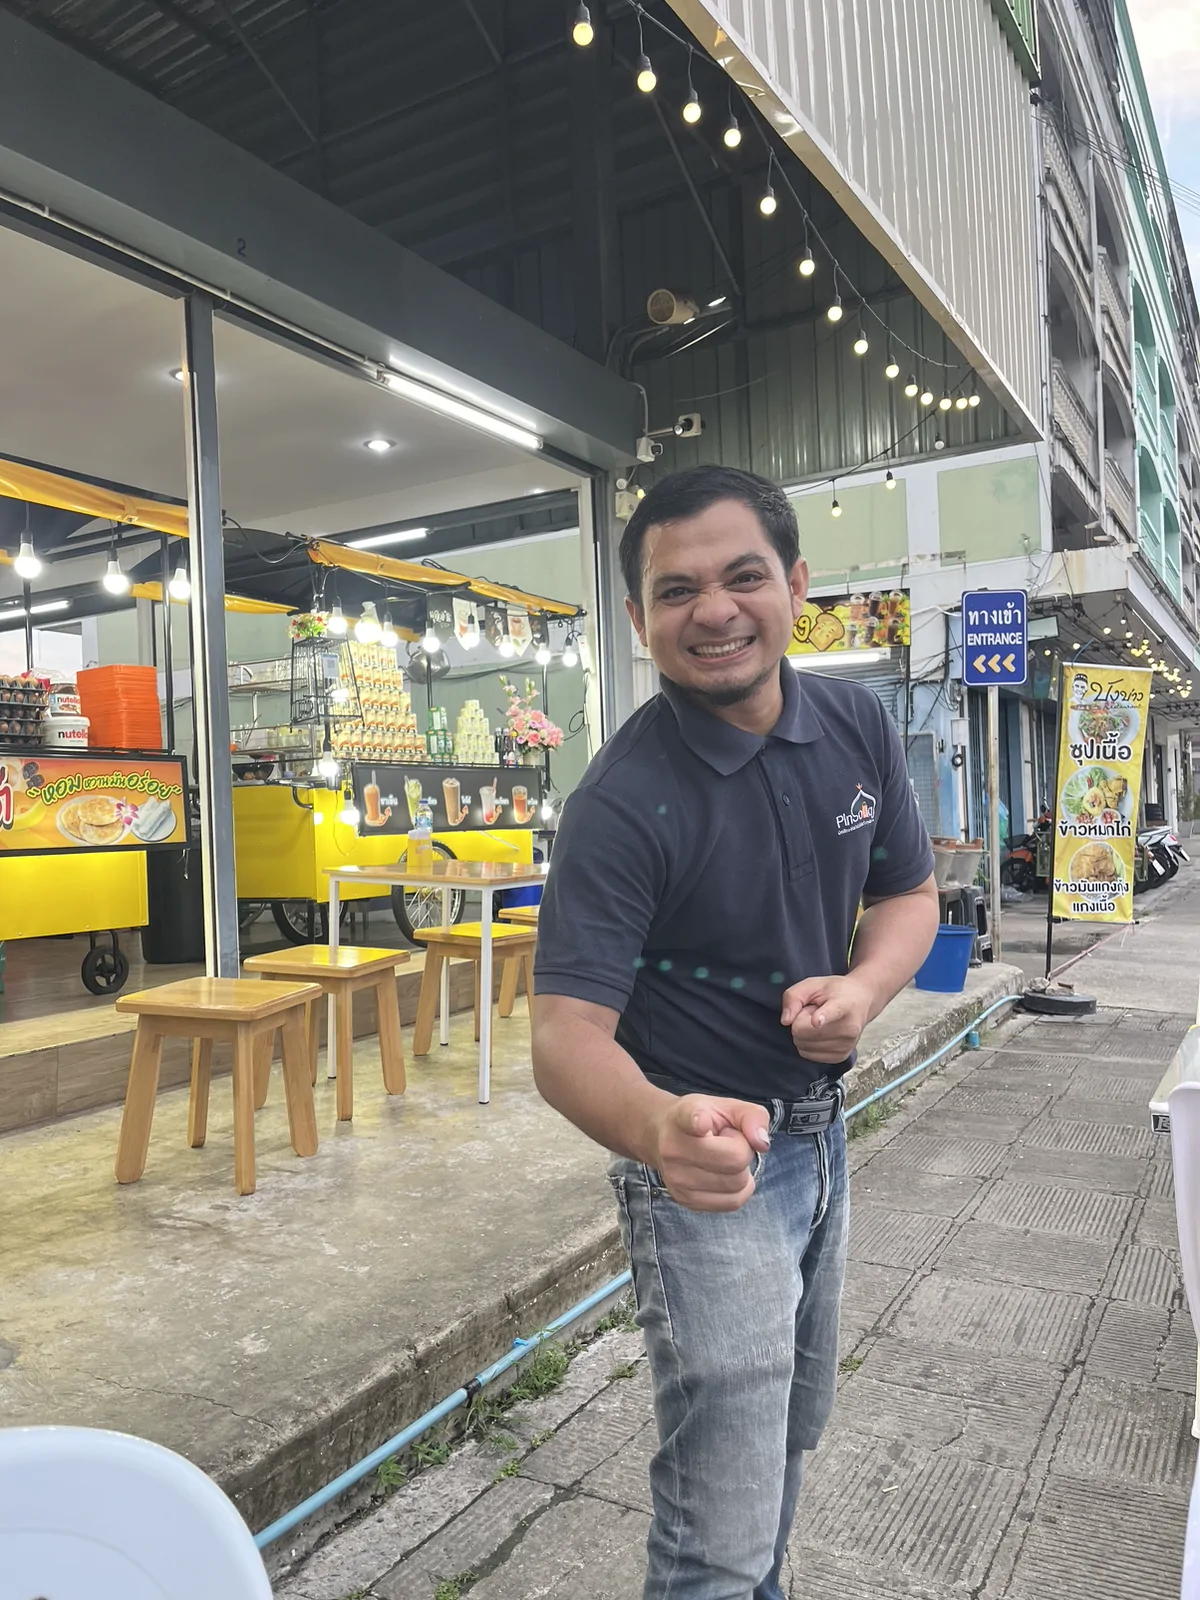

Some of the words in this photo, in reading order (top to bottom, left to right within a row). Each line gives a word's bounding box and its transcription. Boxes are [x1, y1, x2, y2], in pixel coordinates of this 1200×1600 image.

[237, 238, 246, 257] 2
[968, 602, 1021, 625] ทางเข้า
[967, 632, 1022, 646] ENTRANCE
[1070, 733, 1132, 766] ซุปเนื้อ
[1058, 820, 1132, 837] ข้าวหมกไก่
[1054, 880, 1130, 896] ข้าวมันแกงกุ้ง
[1073, 895, 1116, 912] แกงเนื้อ
